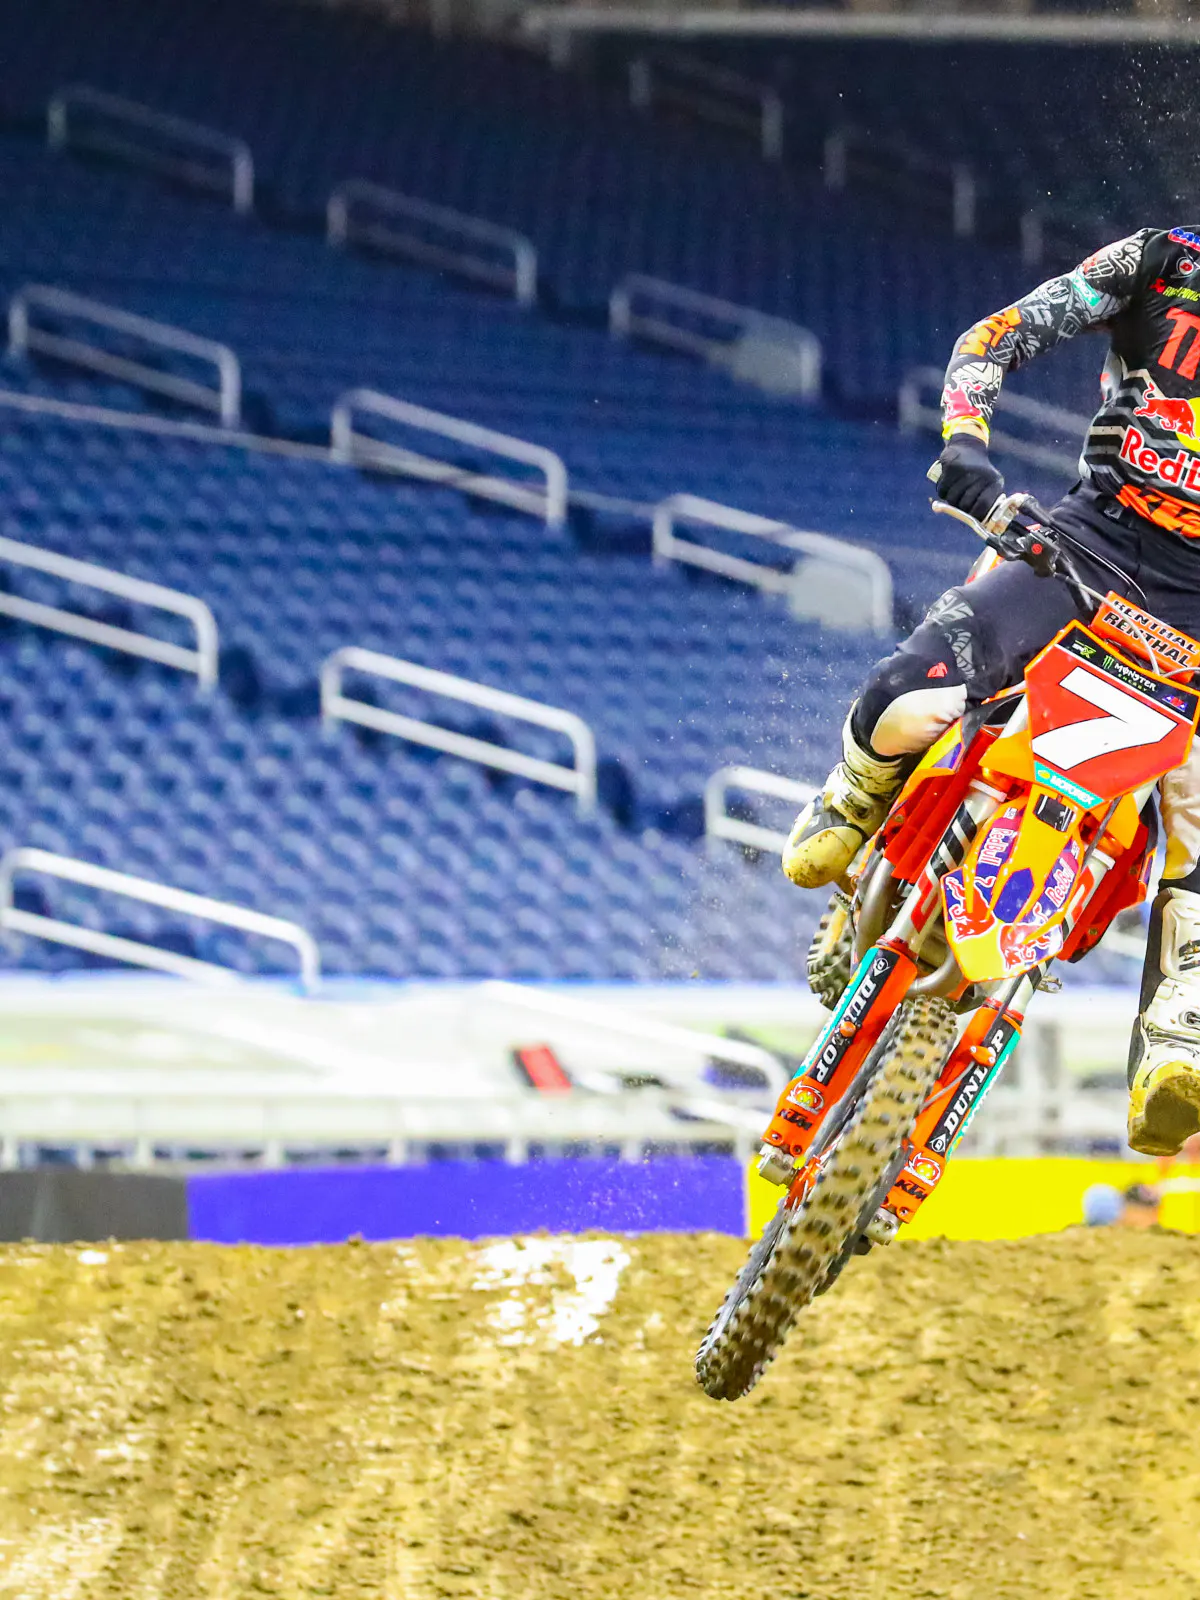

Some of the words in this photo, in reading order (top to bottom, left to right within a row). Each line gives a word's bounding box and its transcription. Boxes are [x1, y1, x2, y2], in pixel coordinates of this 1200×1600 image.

[1119, 424, 1188, 487] Red
[1031, 665, 1179, 772] 7
[778, 1109, 813, 1131] KTM
[894, 1179, 928, 1201] KTM
